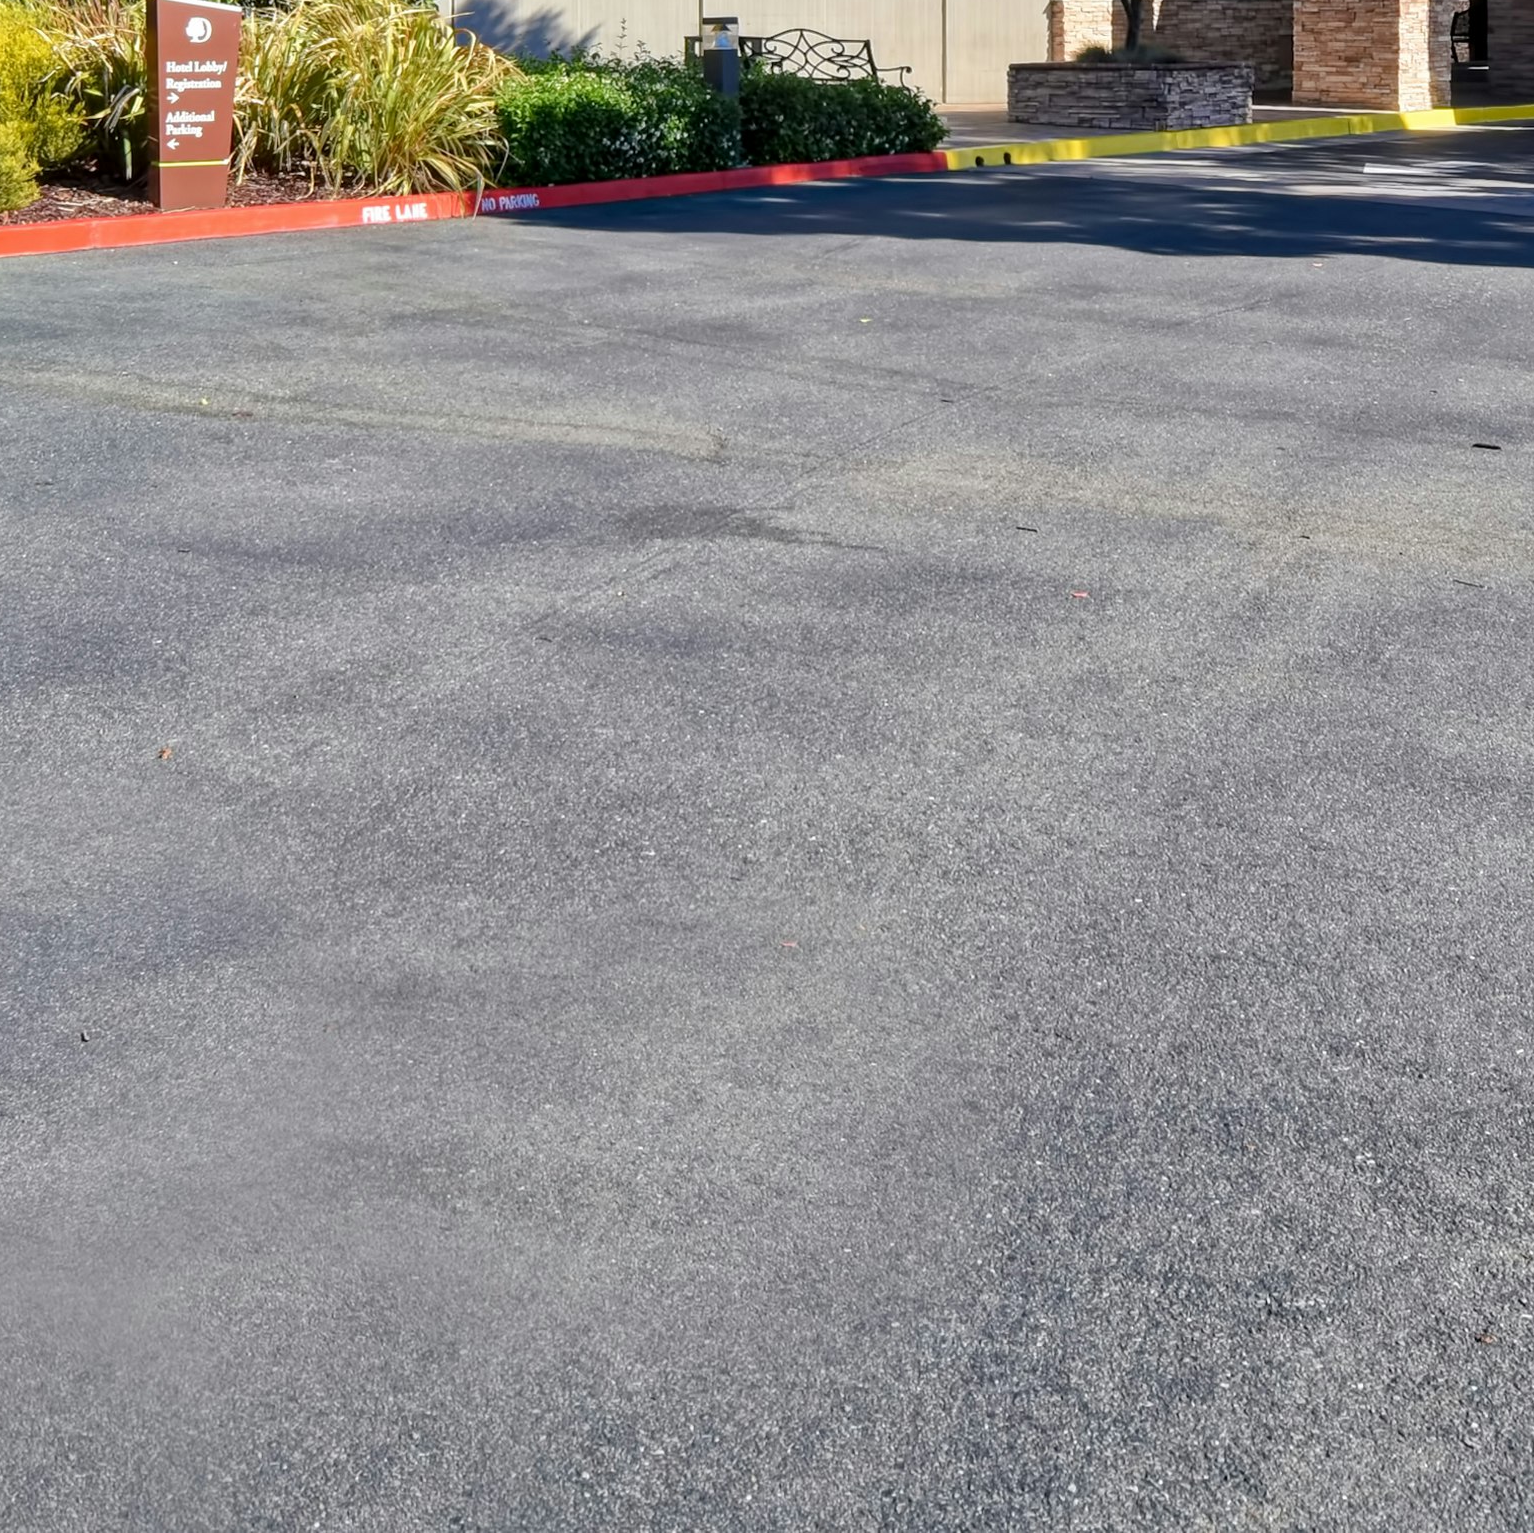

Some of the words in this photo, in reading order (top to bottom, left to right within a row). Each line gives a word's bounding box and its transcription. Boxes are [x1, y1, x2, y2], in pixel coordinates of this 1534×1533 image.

[166, 60, 193, 73] Hotel
[194, 60, 228, 75] Lobby/
[165, 77, 222, 93] Registration
[165, 110, 215, 123] Additional
[165, 123, 203, 138] Parking
[481, 198, 496, 212] NO
[499, 193, 540, 210] PARKING
[362, 205, 391, 223] FIRE
[395, 202, 428, 221] LANE
